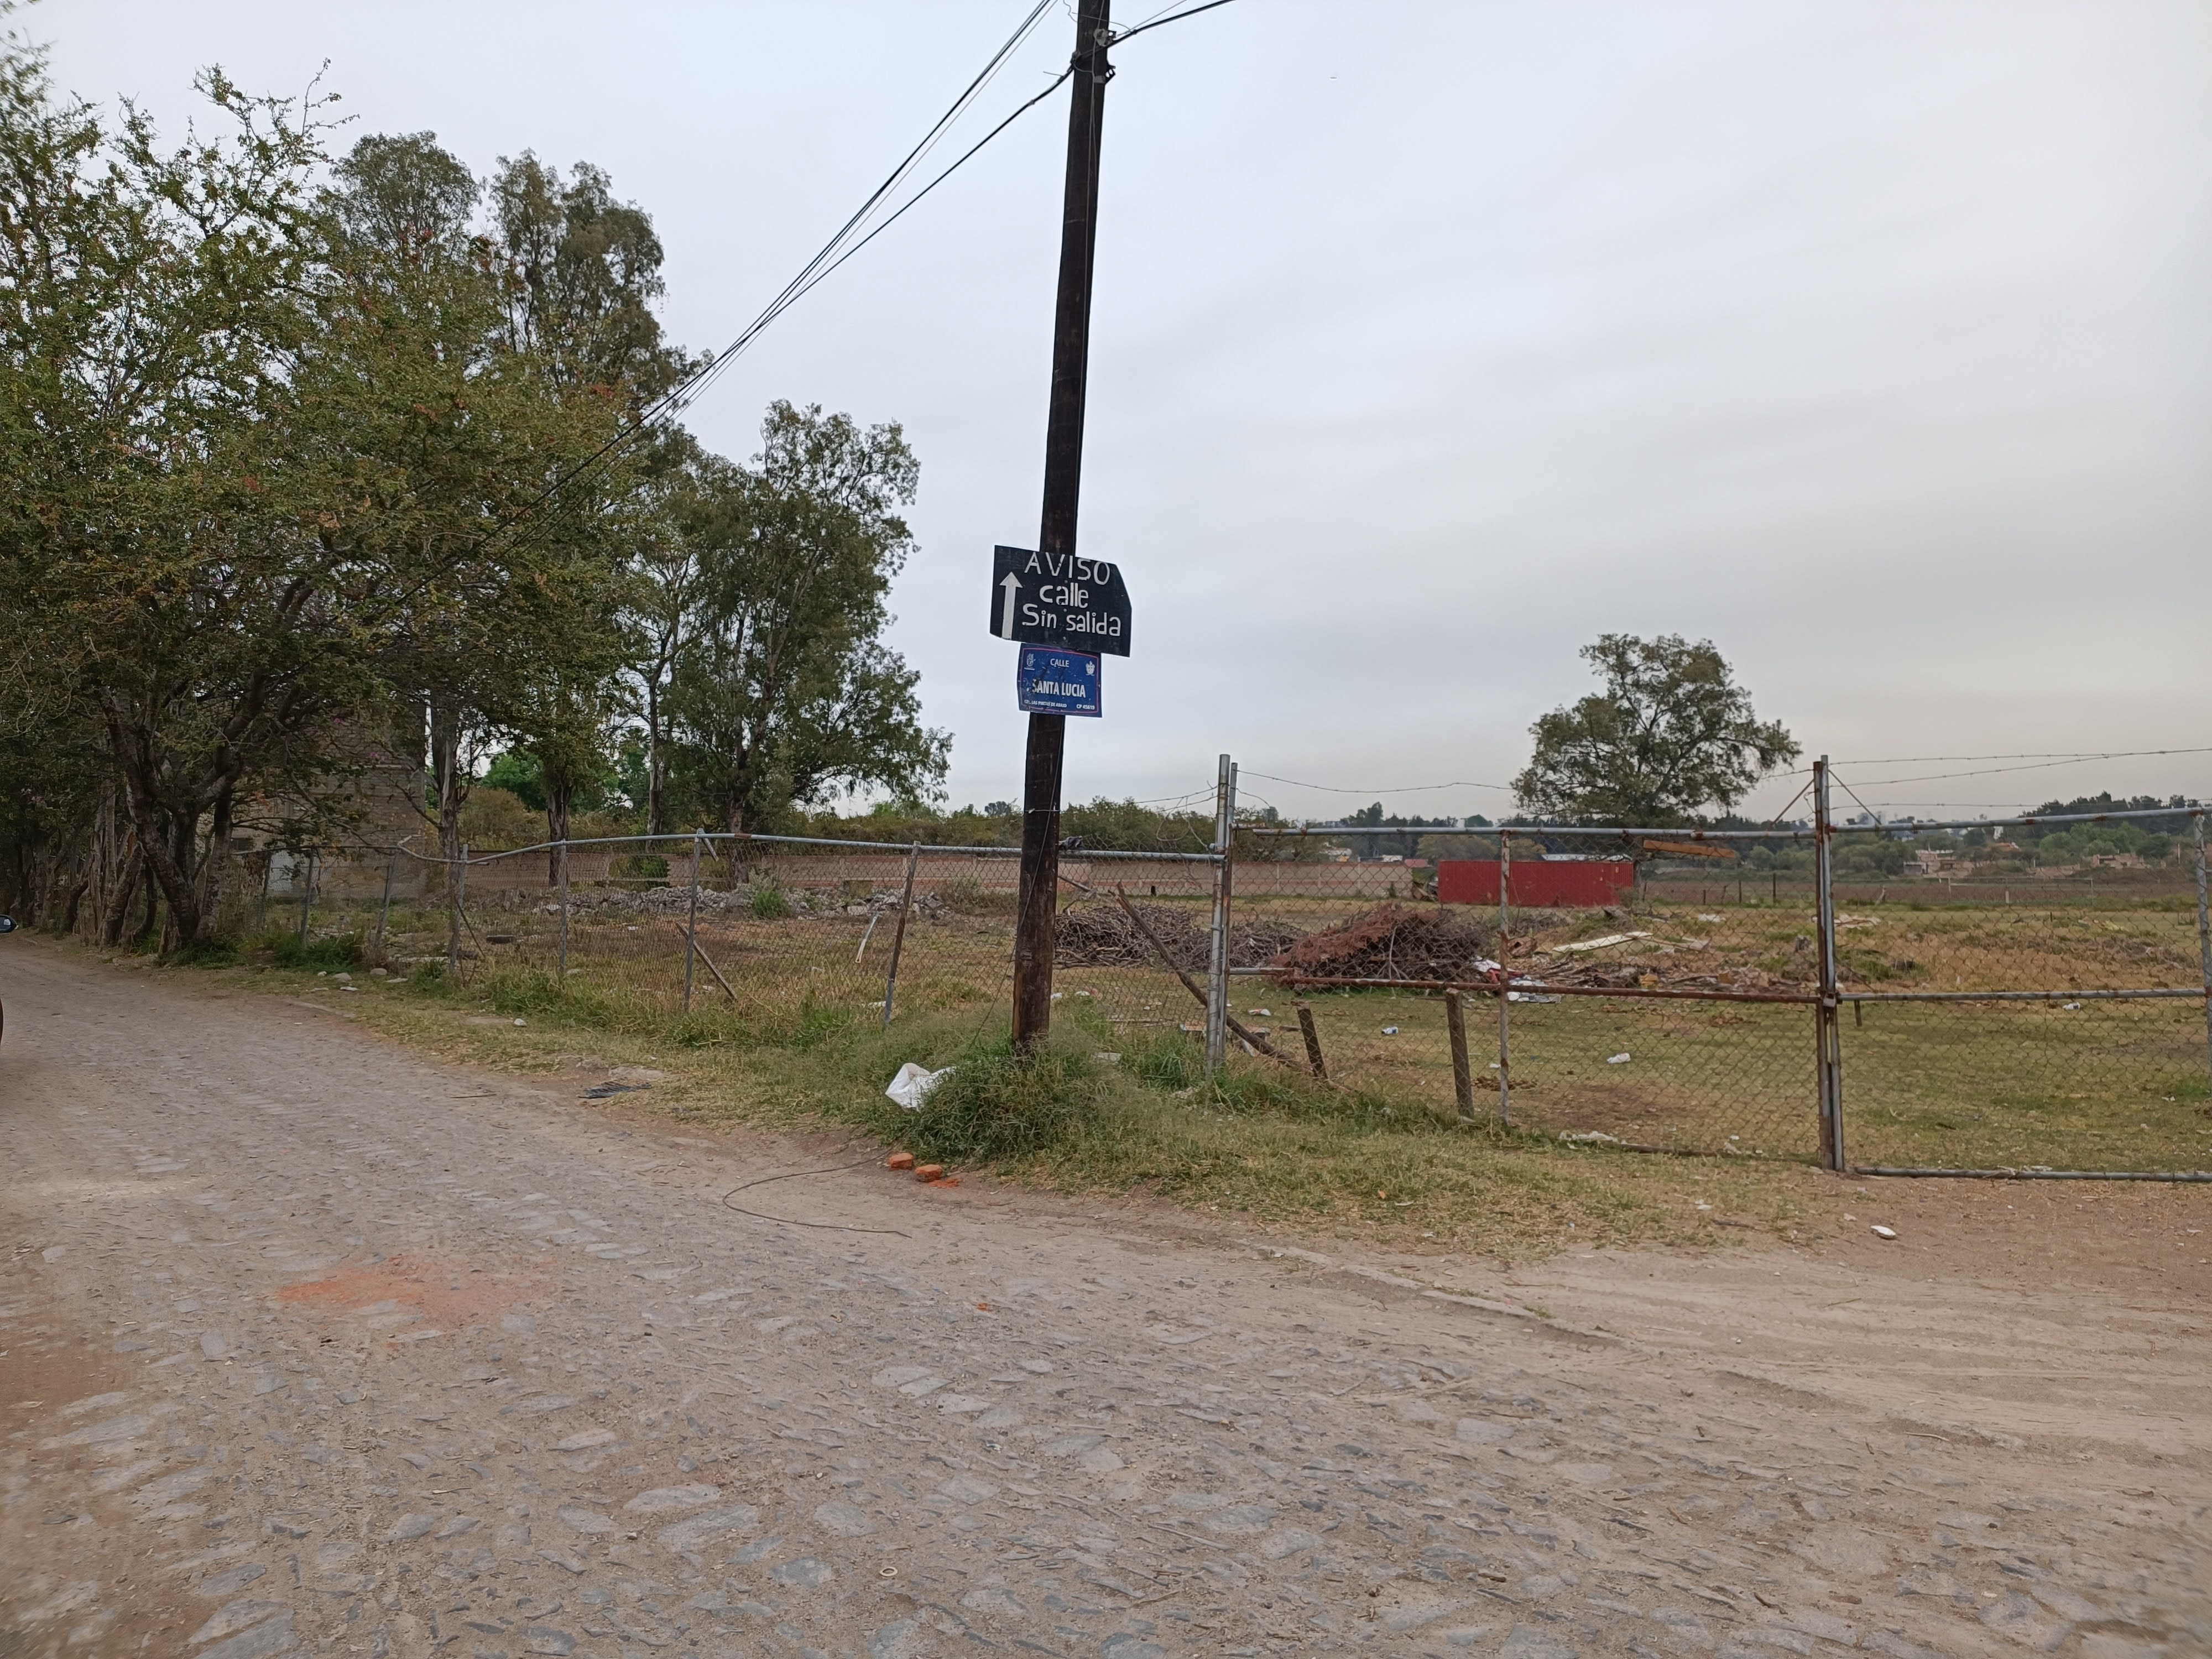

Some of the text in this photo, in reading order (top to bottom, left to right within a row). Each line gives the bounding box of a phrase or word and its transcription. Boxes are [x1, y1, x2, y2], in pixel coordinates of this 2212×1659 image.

[1025, 552, 1110, 585] AVISO
[1040, 582, 1088, 608] calle
[1022, 603, 1121, 637] Sin salida
[1050, 658, 1070, 667] CALLE
[1032, 679, 1086, 698] SANTA LUCIA
